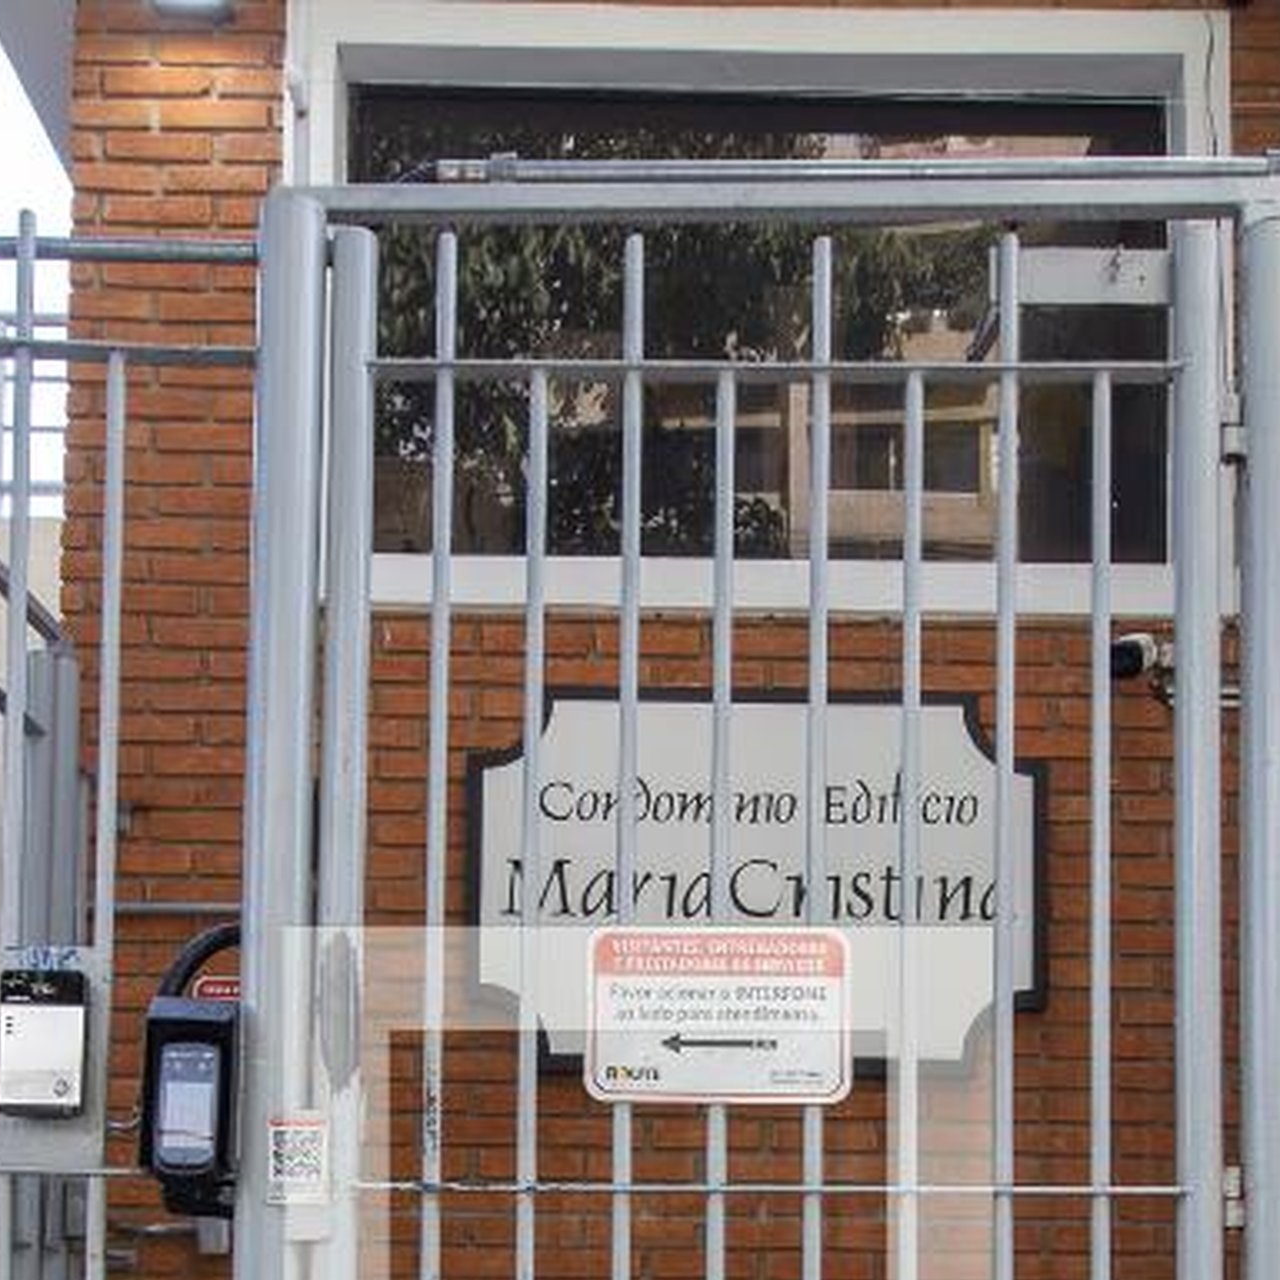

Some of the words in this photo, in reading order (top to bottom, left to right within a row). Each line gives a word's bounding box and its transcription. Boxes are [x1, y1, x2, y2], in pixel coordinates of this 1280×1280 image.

[538, 776, 797, 825] Condomnio
[824, 772, 979, 825] Edifcio
[500, 859, 713, 918] Maria
